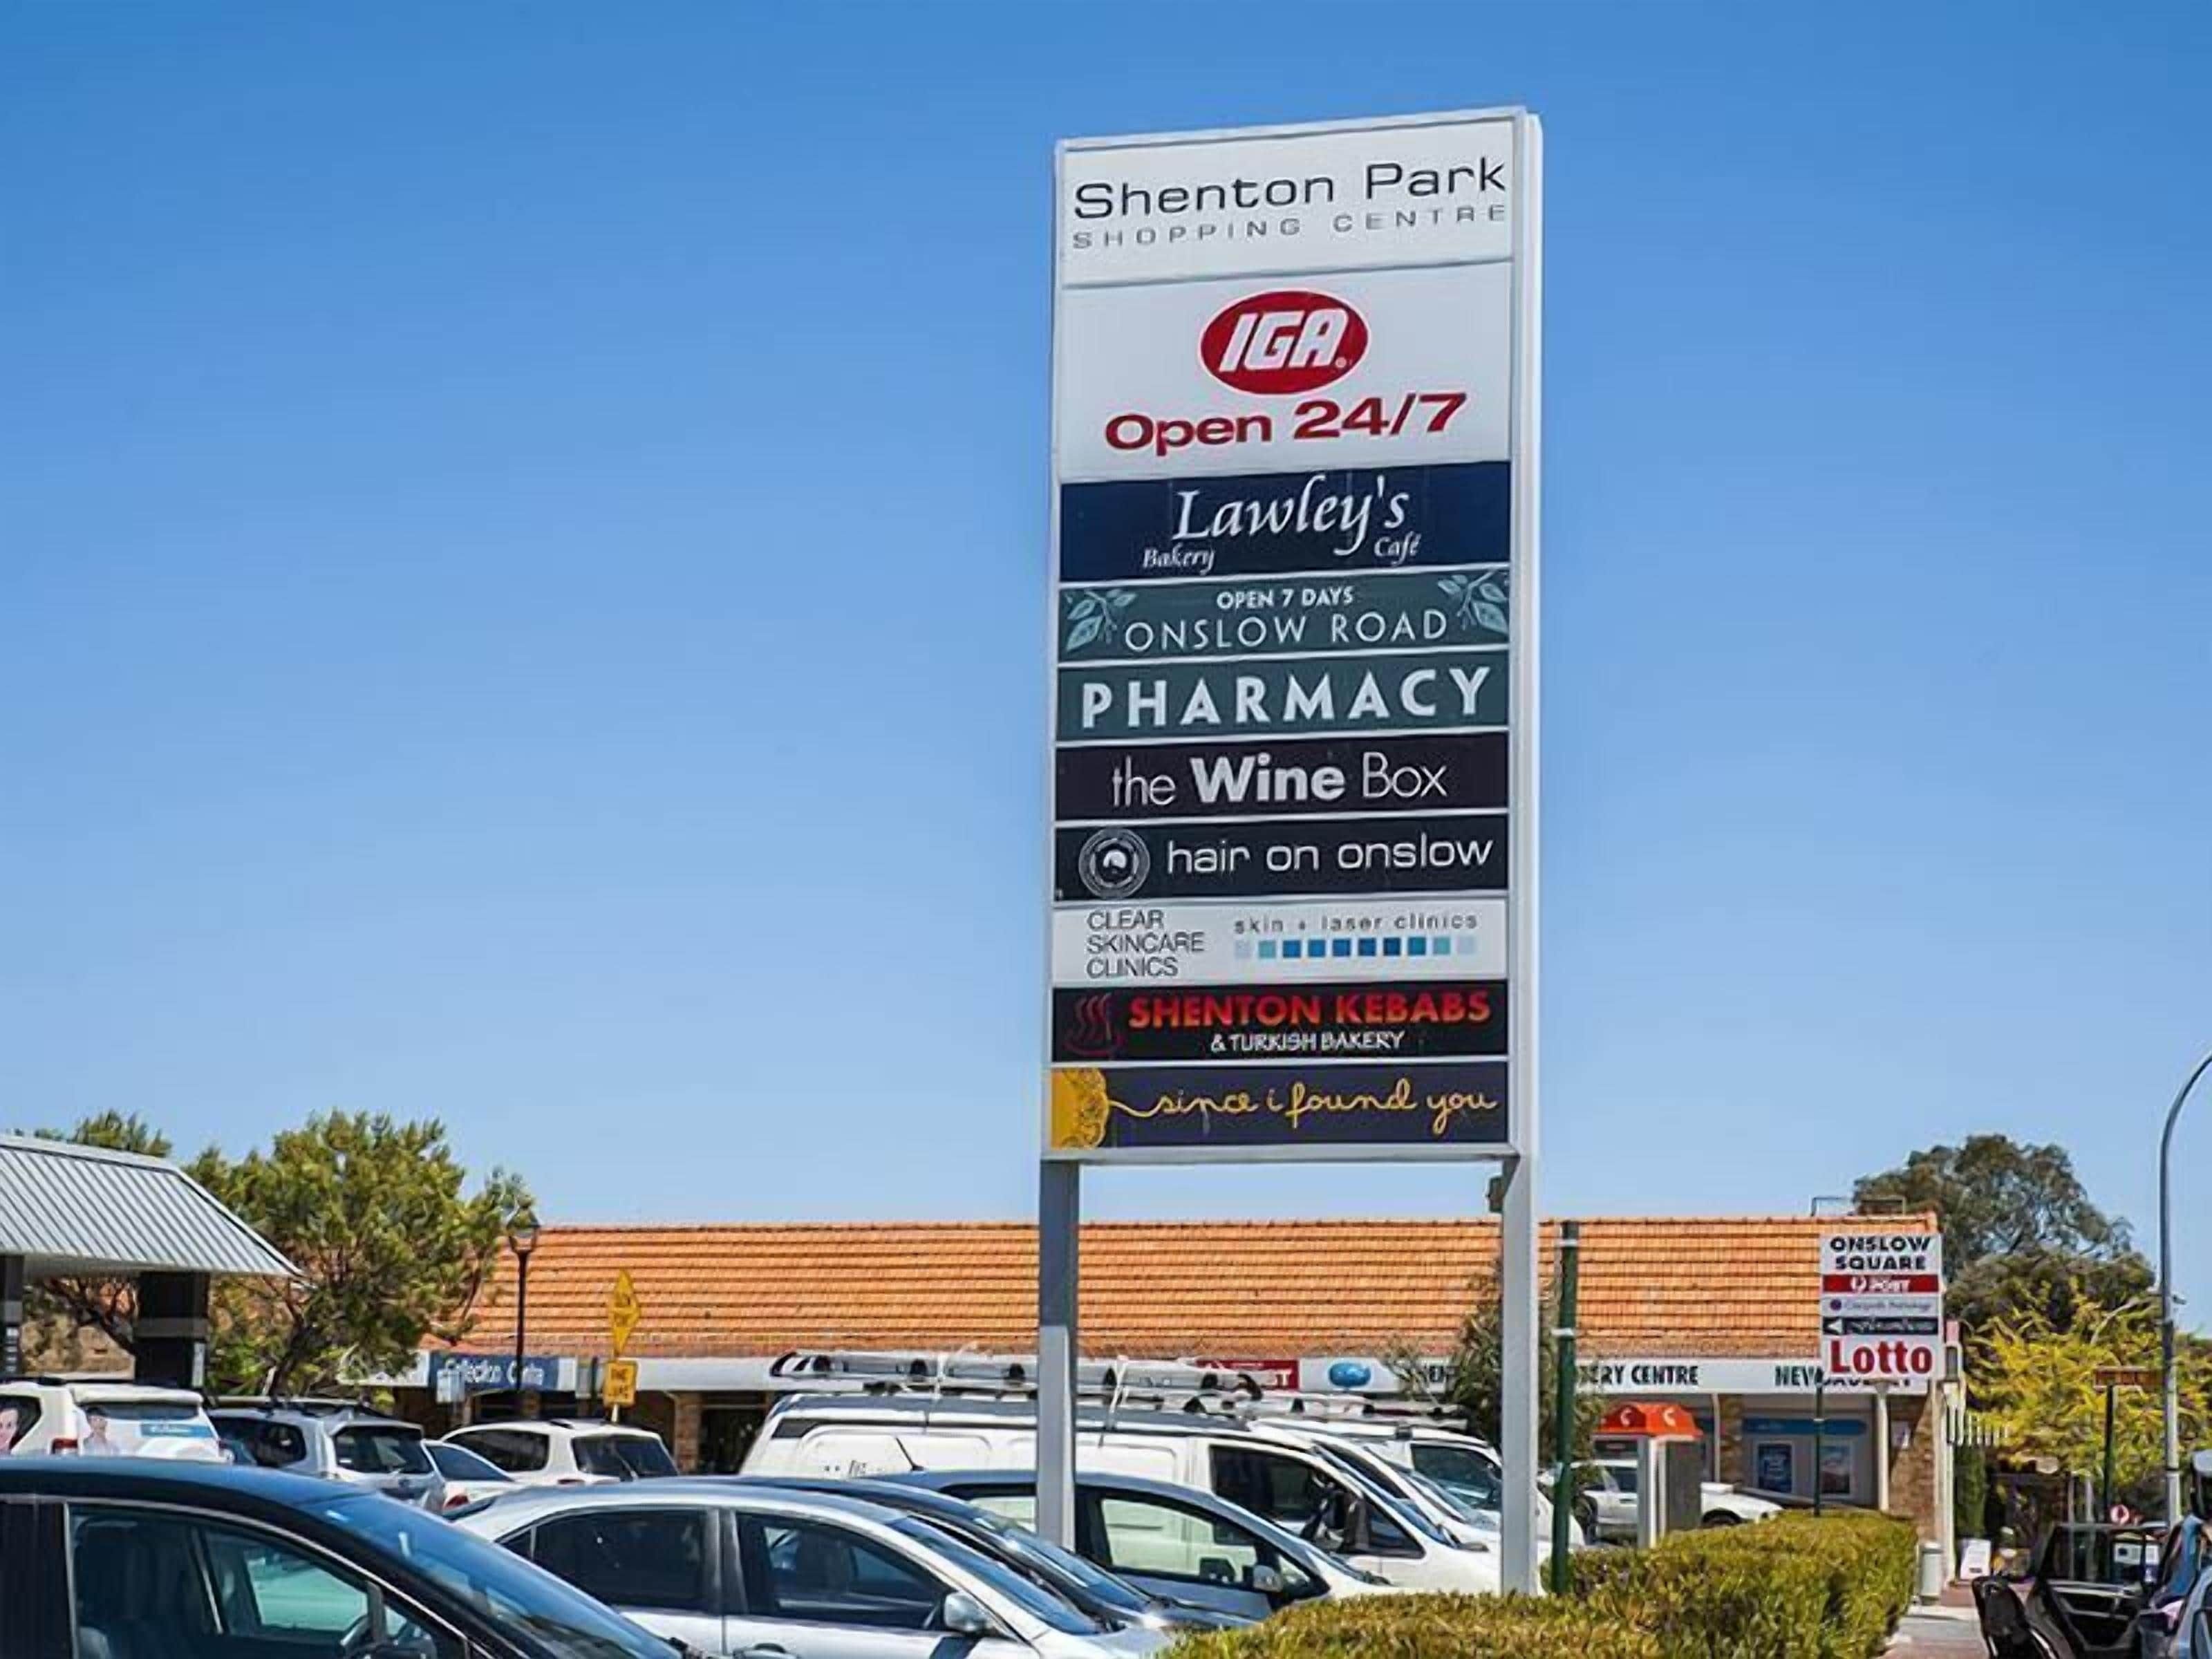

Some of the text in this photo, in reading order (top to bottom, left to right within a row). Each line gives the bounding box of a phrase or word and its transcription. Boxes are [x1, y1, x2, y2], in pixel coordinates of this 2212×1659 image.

[1074, 157, 1506, 218] Shenton Park
[1072, 205, 1506, 250] SHOPPING CENTRE
[1217, 308, 1350, 373] IGA
[1105, 393, 1467, 456] Open 24/7
[1172, 475, 1409, 556] Lawley's
[1142, 545, 1215, 575] Bakery
[1216, 585, 1355, 610] OPEN 7 DAYS
[1125, 609, 1447, 653] ONSLOW ROAD
[1082, 666, 1491, 730] PHARMACY
[1111, 751, 1449, 807] the Wine Box
[1168, 832, 1494, 874] hair on onslow
[1087, 910, 1165, 930] CLEAR
[1233, 915, 1284, 934] skin
[1321, 915, 1382, 932] laser
[1394, 912, 1478, 930] clinics
[1086, 931, 1205, 955] SKINCARE
[1086, 956, 1179, 979] CLINICS
[1128, 990, 1491, 1029] SHENTON KEBABS
[1210, 1029, 1405, 1052] & TURKISH BAKERY
[1152, 1077, 1499, 1135] since i found you
[1830, 1236, 1931, 1252] ONSLOW
[1835, 1255, 1927, 1271] SQUARE
[1631, 1365, 1699, 1385] CENTRE
[1830, 1340, 1933, 1374] Lotto
